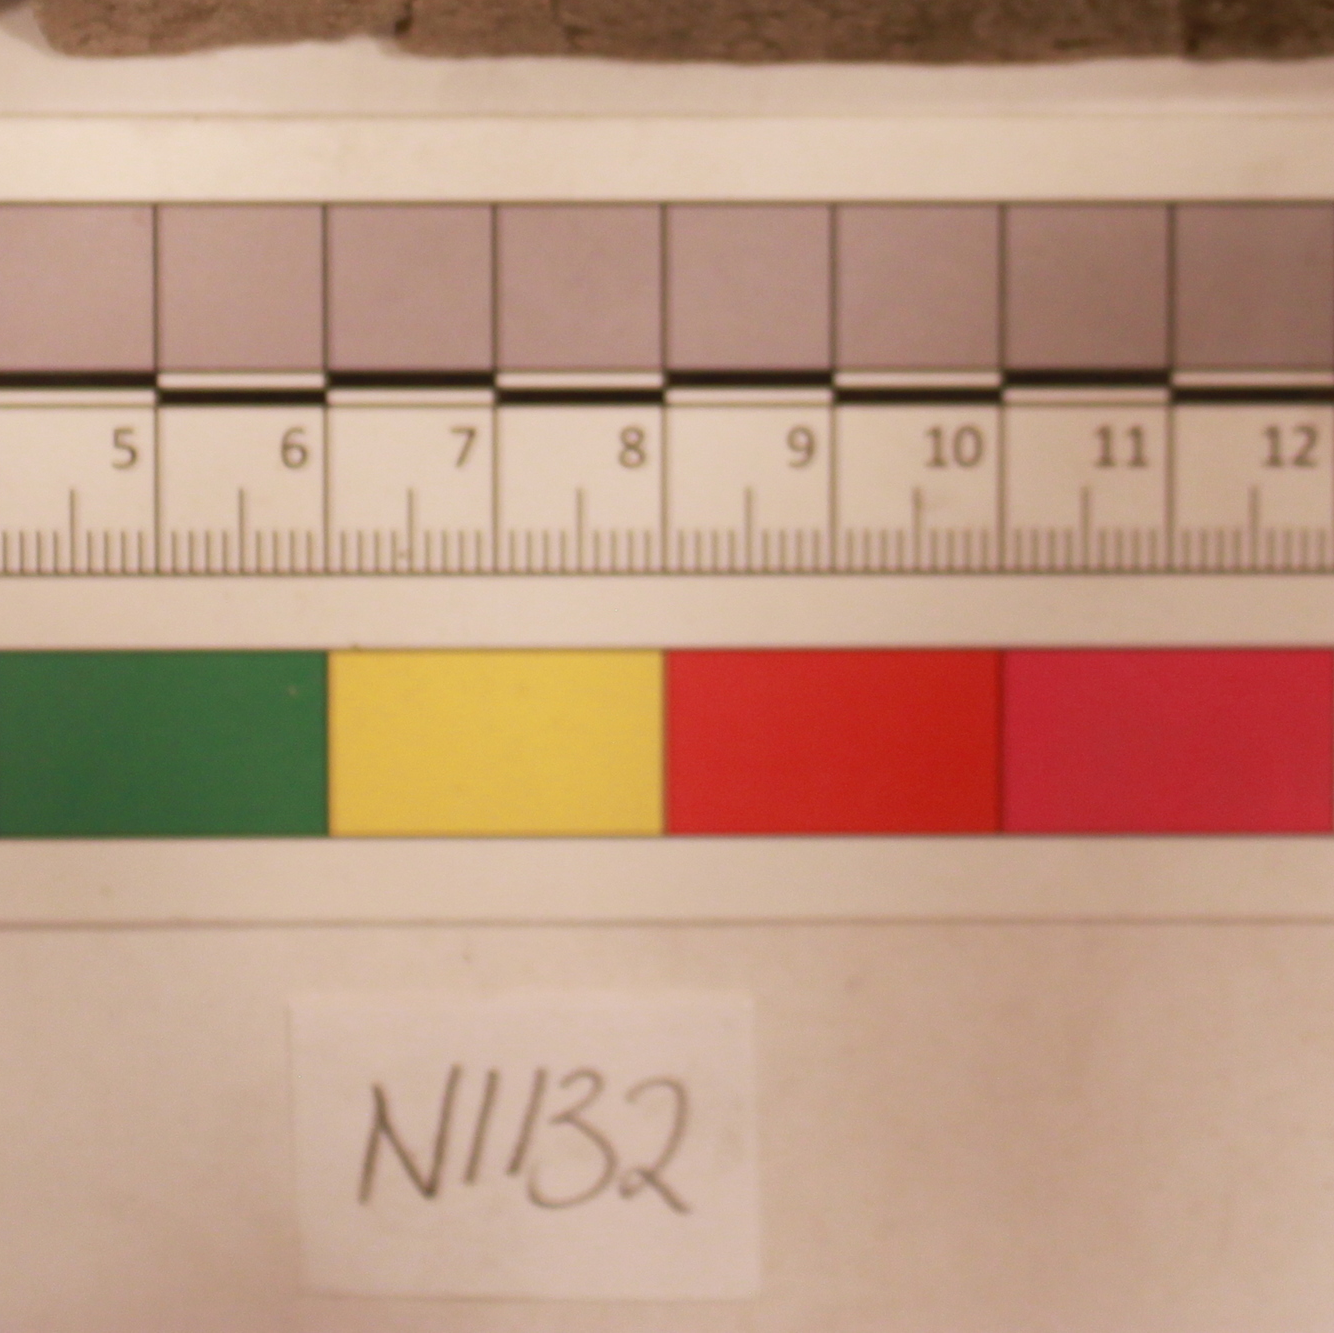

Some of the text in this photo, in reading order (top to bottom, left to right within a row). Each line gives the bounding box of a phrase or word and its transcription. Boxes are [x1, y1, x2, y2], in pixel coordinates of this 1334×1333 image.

[112, 427, 139, 470] 5
[279, 426, 310, 470] 6
[451, 426, 478, 469] 7
[618, 426, 648, 469] 8
[786, 425, 817, 468] 9
[927, 425, 984, 469] 10
[1097, 425, 1147, 469] 11
[1265, 424, 1318, 468] 12
